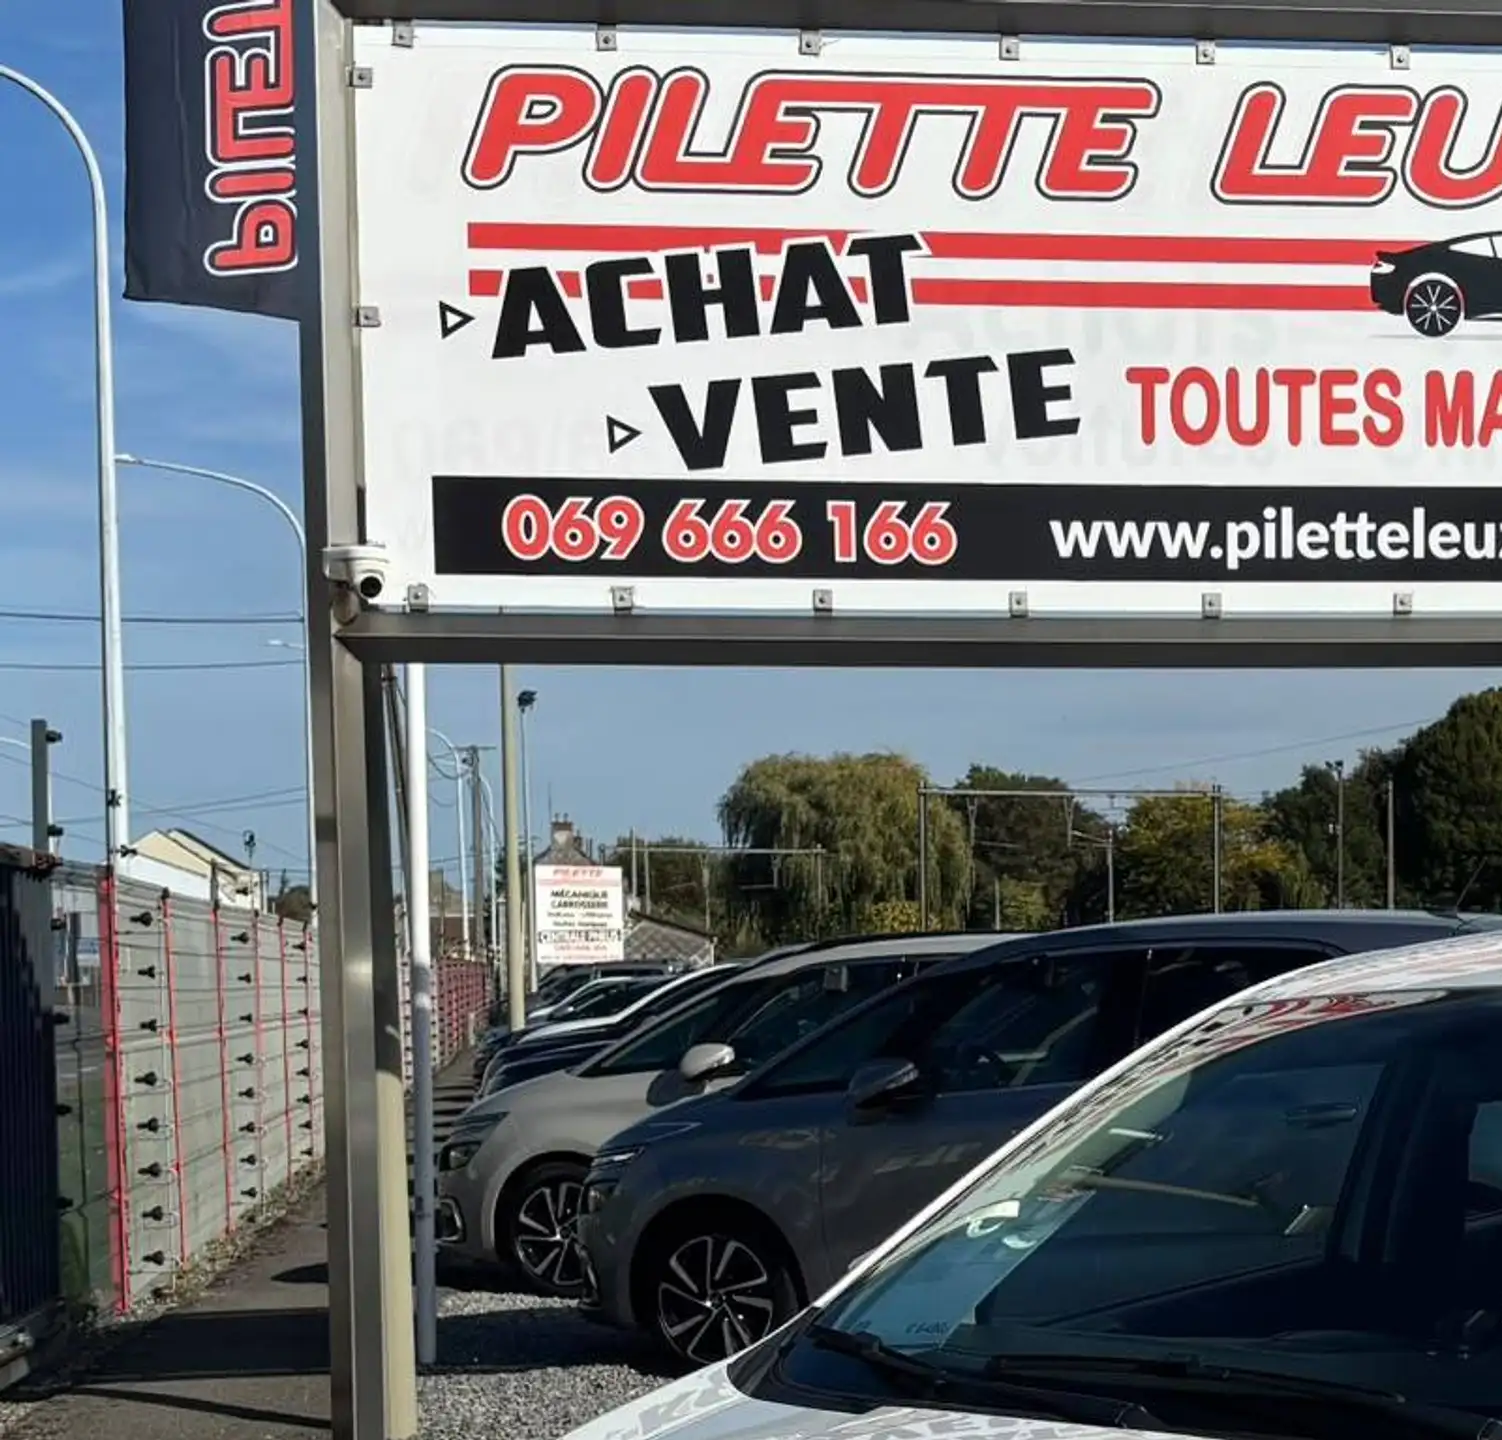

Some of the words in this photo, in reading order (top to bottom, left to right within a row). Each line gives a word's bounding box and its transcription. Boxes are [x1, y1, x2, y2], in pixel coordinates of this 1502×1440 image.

[461, 64, 1161, 201] PILETTE
[491, 234, 924, 359] ACHAT
[647, 348, 1082, 471] VENTE
[1126, 367, 1404, 447] TOUTES
[502, 493, 645, 561] 069
[661, 497, 802, 564] 666
[825, 499, 958, 565] 166
